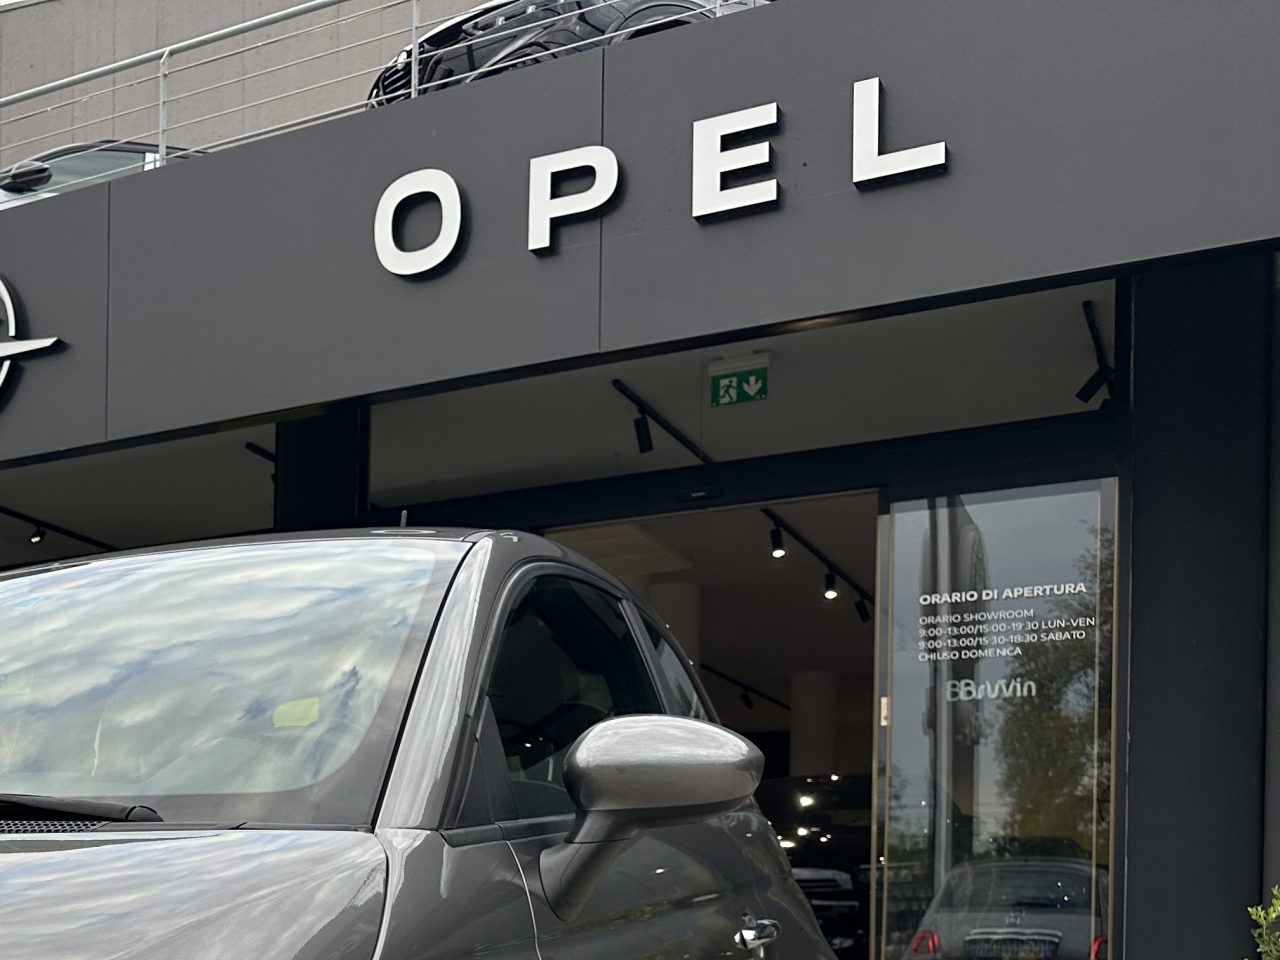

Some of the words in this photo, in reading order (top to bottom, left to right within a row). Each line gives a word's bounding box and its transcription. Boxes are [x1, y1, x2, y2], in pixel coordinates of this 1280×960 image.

[373, 76, 946, 276] OPEL
[919, 590, 978, 606] ORARIO
[982, 588, 998, 600] DI
[1002, 582, 1087, 600] APERTURA
[919, 614, 961, 626] ORARIO
[963, 609, 1034, 623] SHOWROOM
[1041, 616, 1095, 630] LUN-VEN
[1040, 630, 1086, 642] SABATO
[917, 651, 959, 662] CHIUSO
